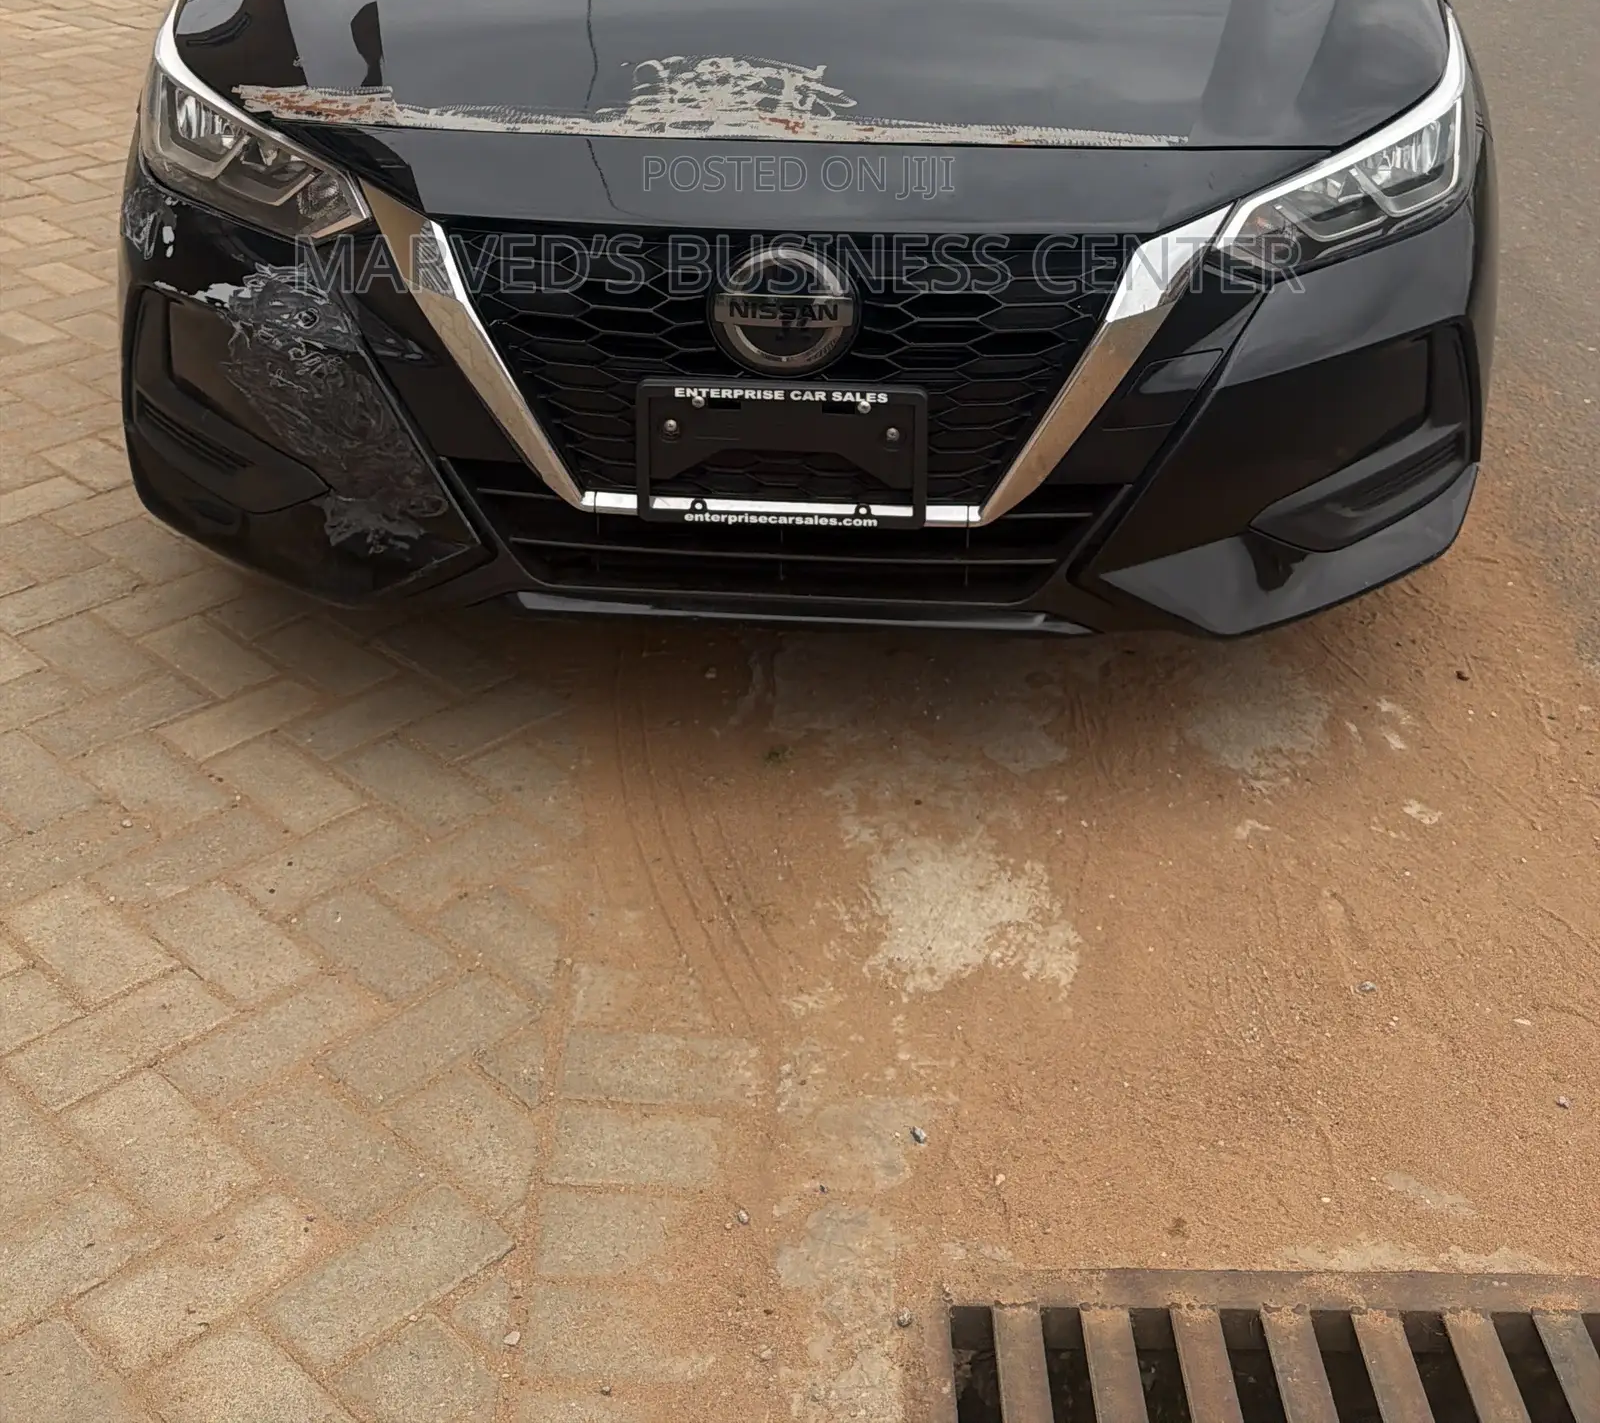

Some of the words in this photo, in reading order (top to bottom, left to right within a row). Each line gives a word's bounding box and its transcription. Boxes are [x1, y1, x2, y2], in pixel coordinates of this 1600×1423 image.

[728, 301, 838, 321] NISSAN
[674, 387, 785, 401] ENTERPRISE
[789, 390, 827, 402] CAR
[831, 391, 889, 404] SALES
[684, 512, 878, 528] enterprisecarsales.com
